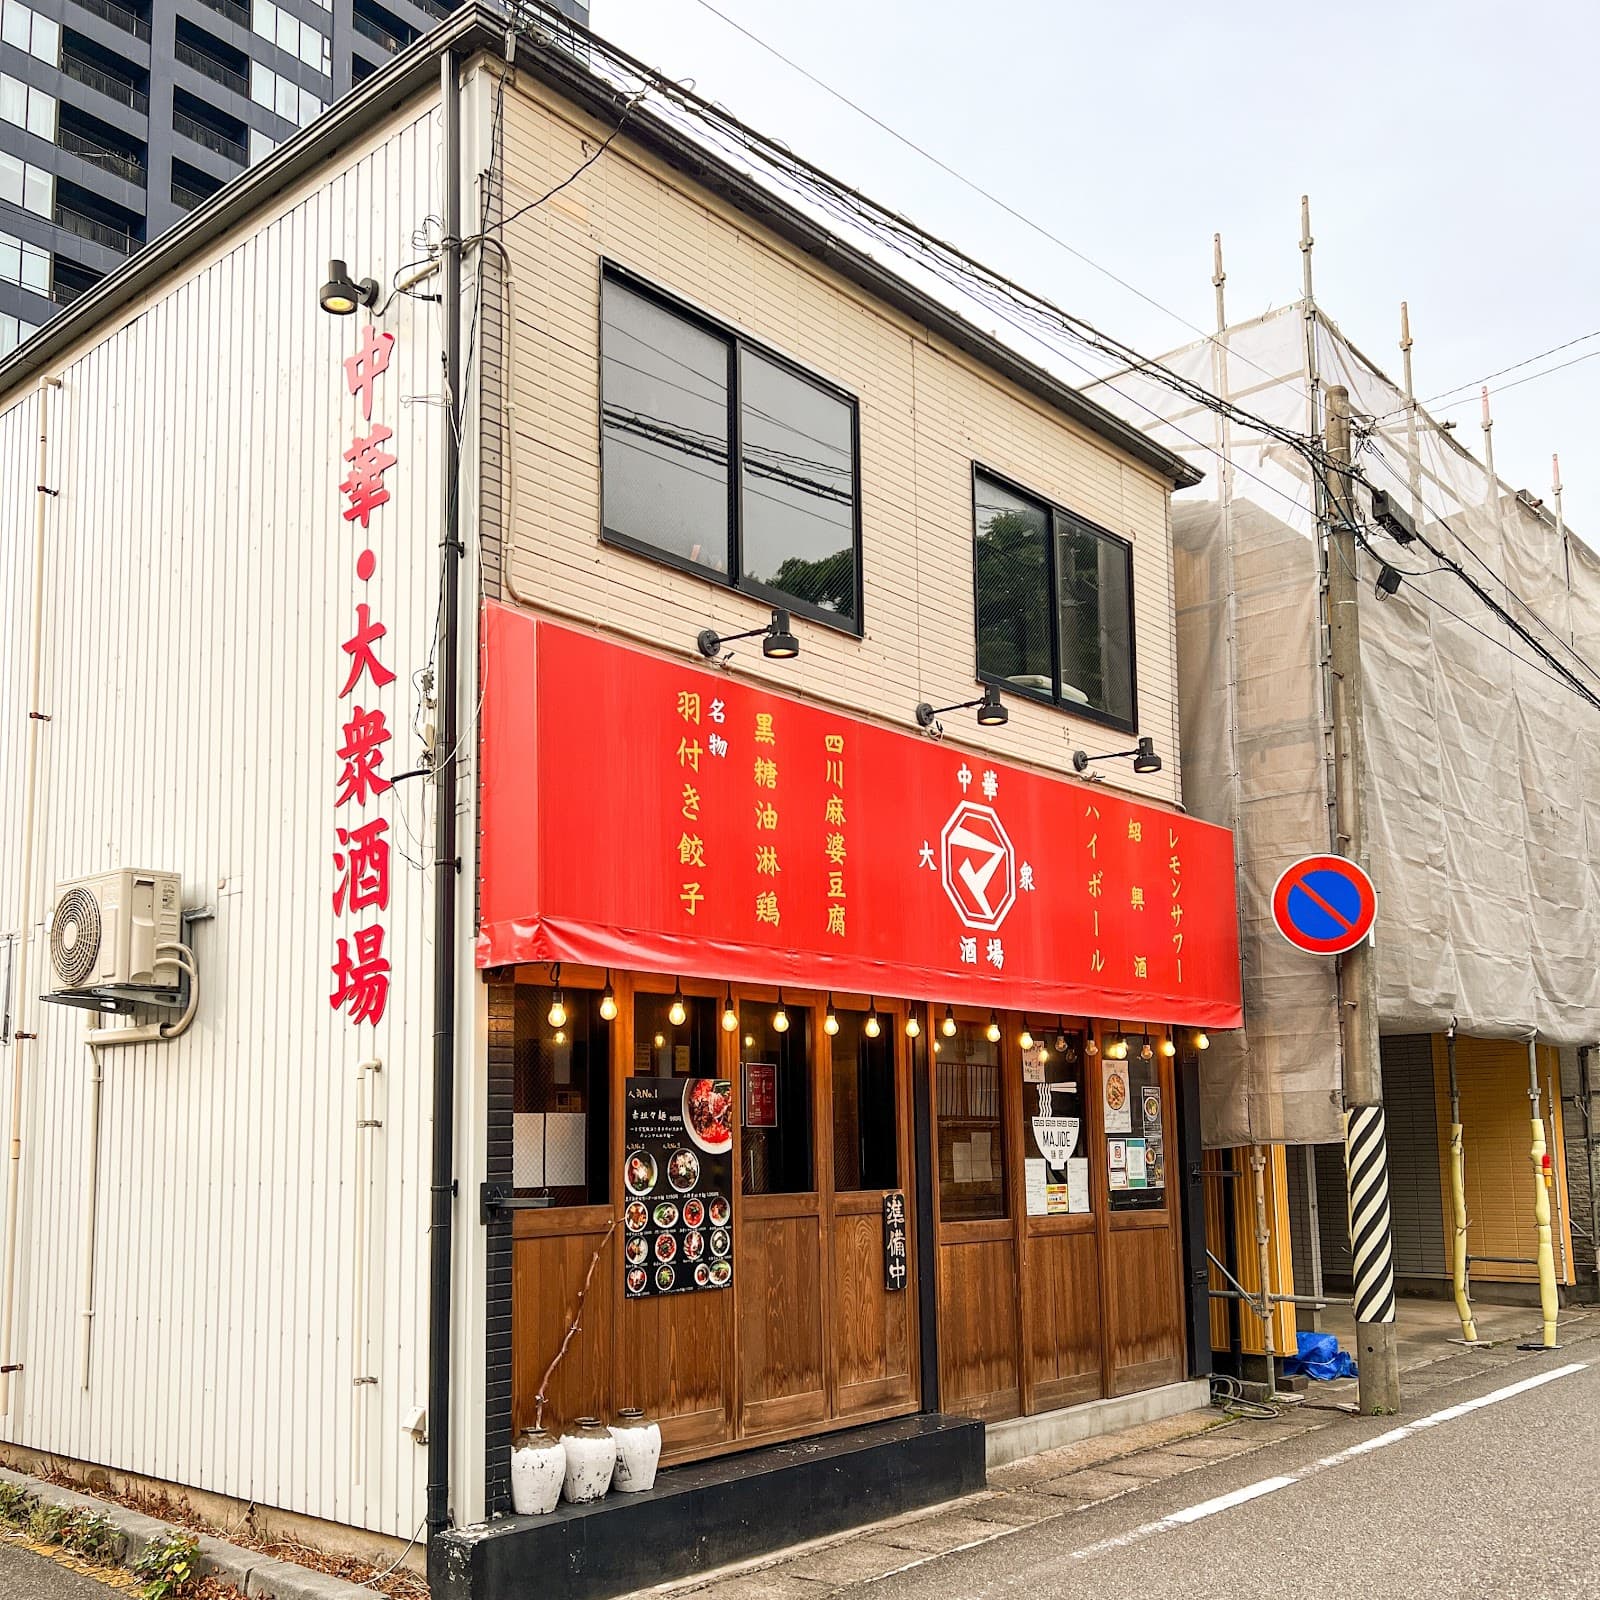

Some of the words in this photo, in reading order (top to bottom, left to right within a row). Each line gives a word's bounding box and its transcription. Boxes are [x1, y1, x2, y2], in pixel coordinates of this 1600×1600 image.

[676, 691, 706, 915] 羽付き餃子
[708, 699, 728, 758] 名物
[957, 763, 998, 801] 中華
[754, 713, 781, 927] 黒糖油淋鶏
[825, 735, 847, 937] 四川麻婆豆腐
[1085, 806, 1104, 973] ハイボール
[959, 935, 1005, 969] 酒場
[1128, 818, 1148, 979] 紹興酒
[1168, 828, 1184, 983] レモンサワー
[1042, 1130, 1071, 1147] MAJIDE
[886, 1199, 906, 1289] 準備中
